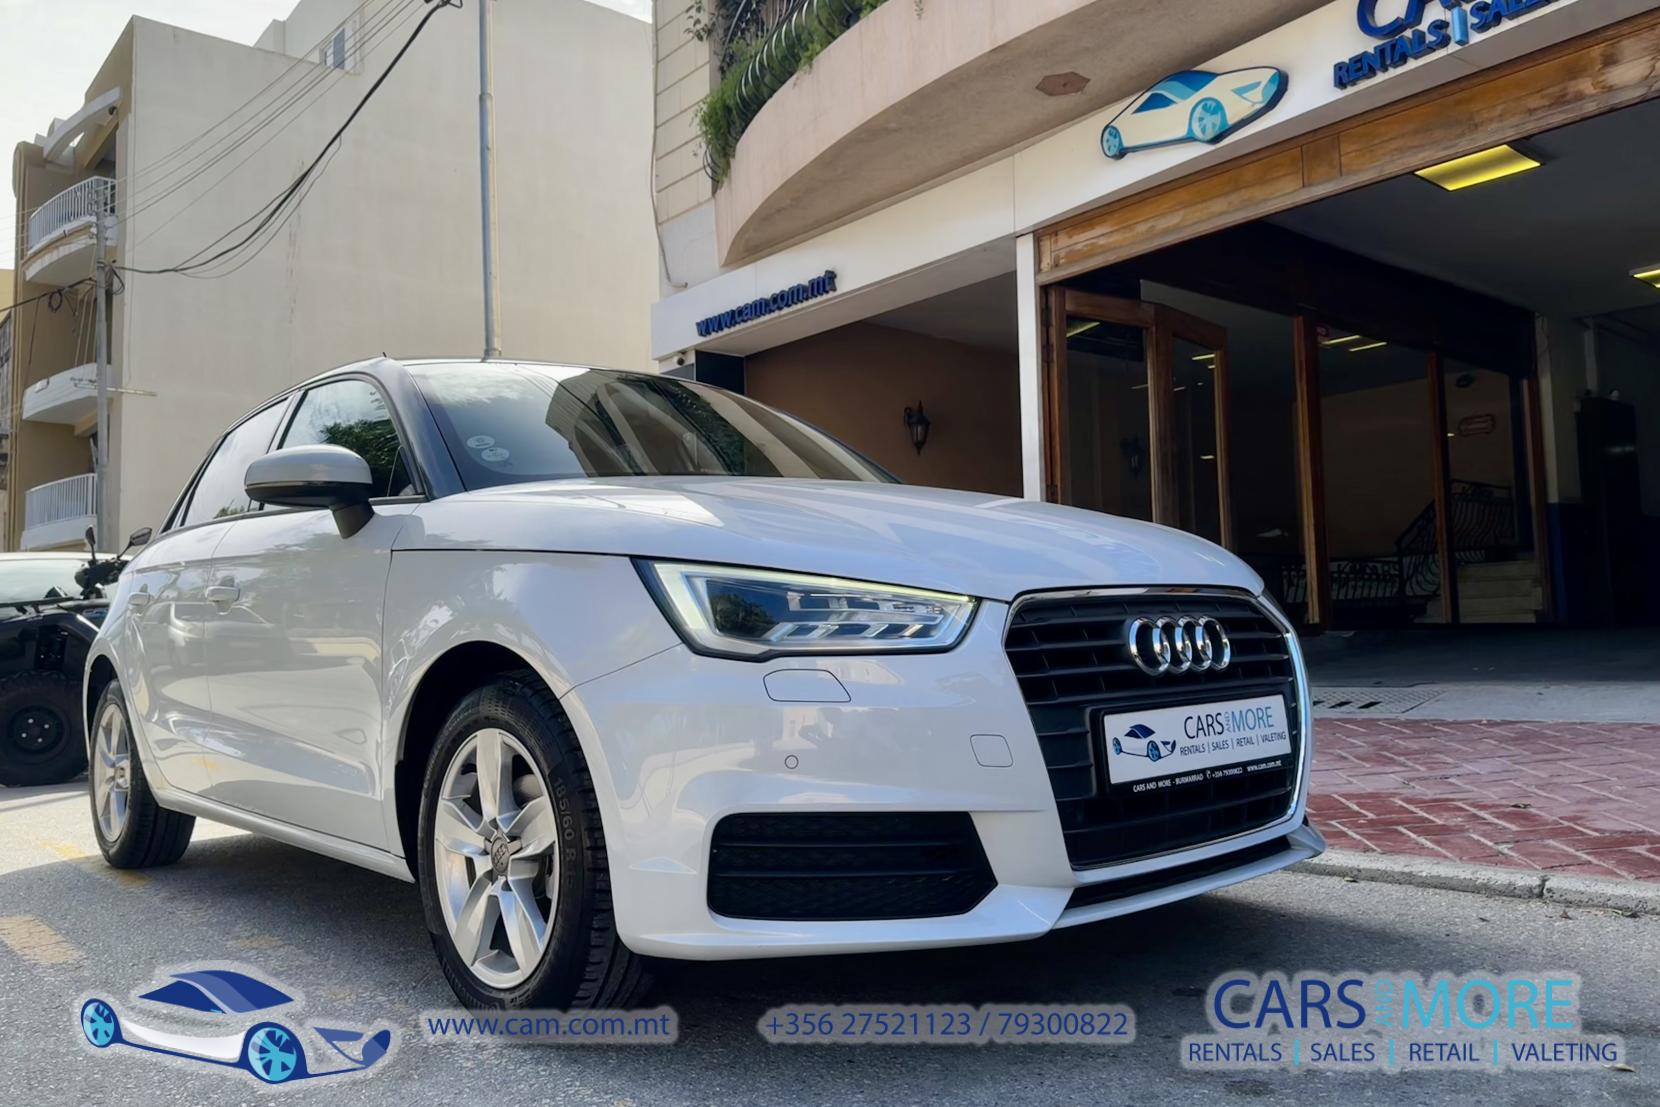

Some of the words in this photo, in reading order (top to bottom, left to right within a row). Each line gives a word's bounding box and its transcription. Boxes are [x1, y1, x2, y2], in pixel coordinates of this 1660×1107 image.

[1333, 19, 1451, 90] RENTALS
[1470, 0, 1554, 34] SAL
[696, 270, 837, 337] www.cam.com.mt
[1180, 744, 1205, 756] RENTALS
[1212, 740, 1229, 751] SALES
[1236, 736, 1255, 747] RETAIL
[1261, 731, 1286, 743] VALETING
[1184, 712, 1225, 739] CARS
[1224, 711, 1232, 733] AND
[1231, 706, 1274, 732] MORE
[554, 777, 575, 840] 185/60
[1133, 783, 1146, 792] CARS
[1146, 781, 1157, 790] AND
